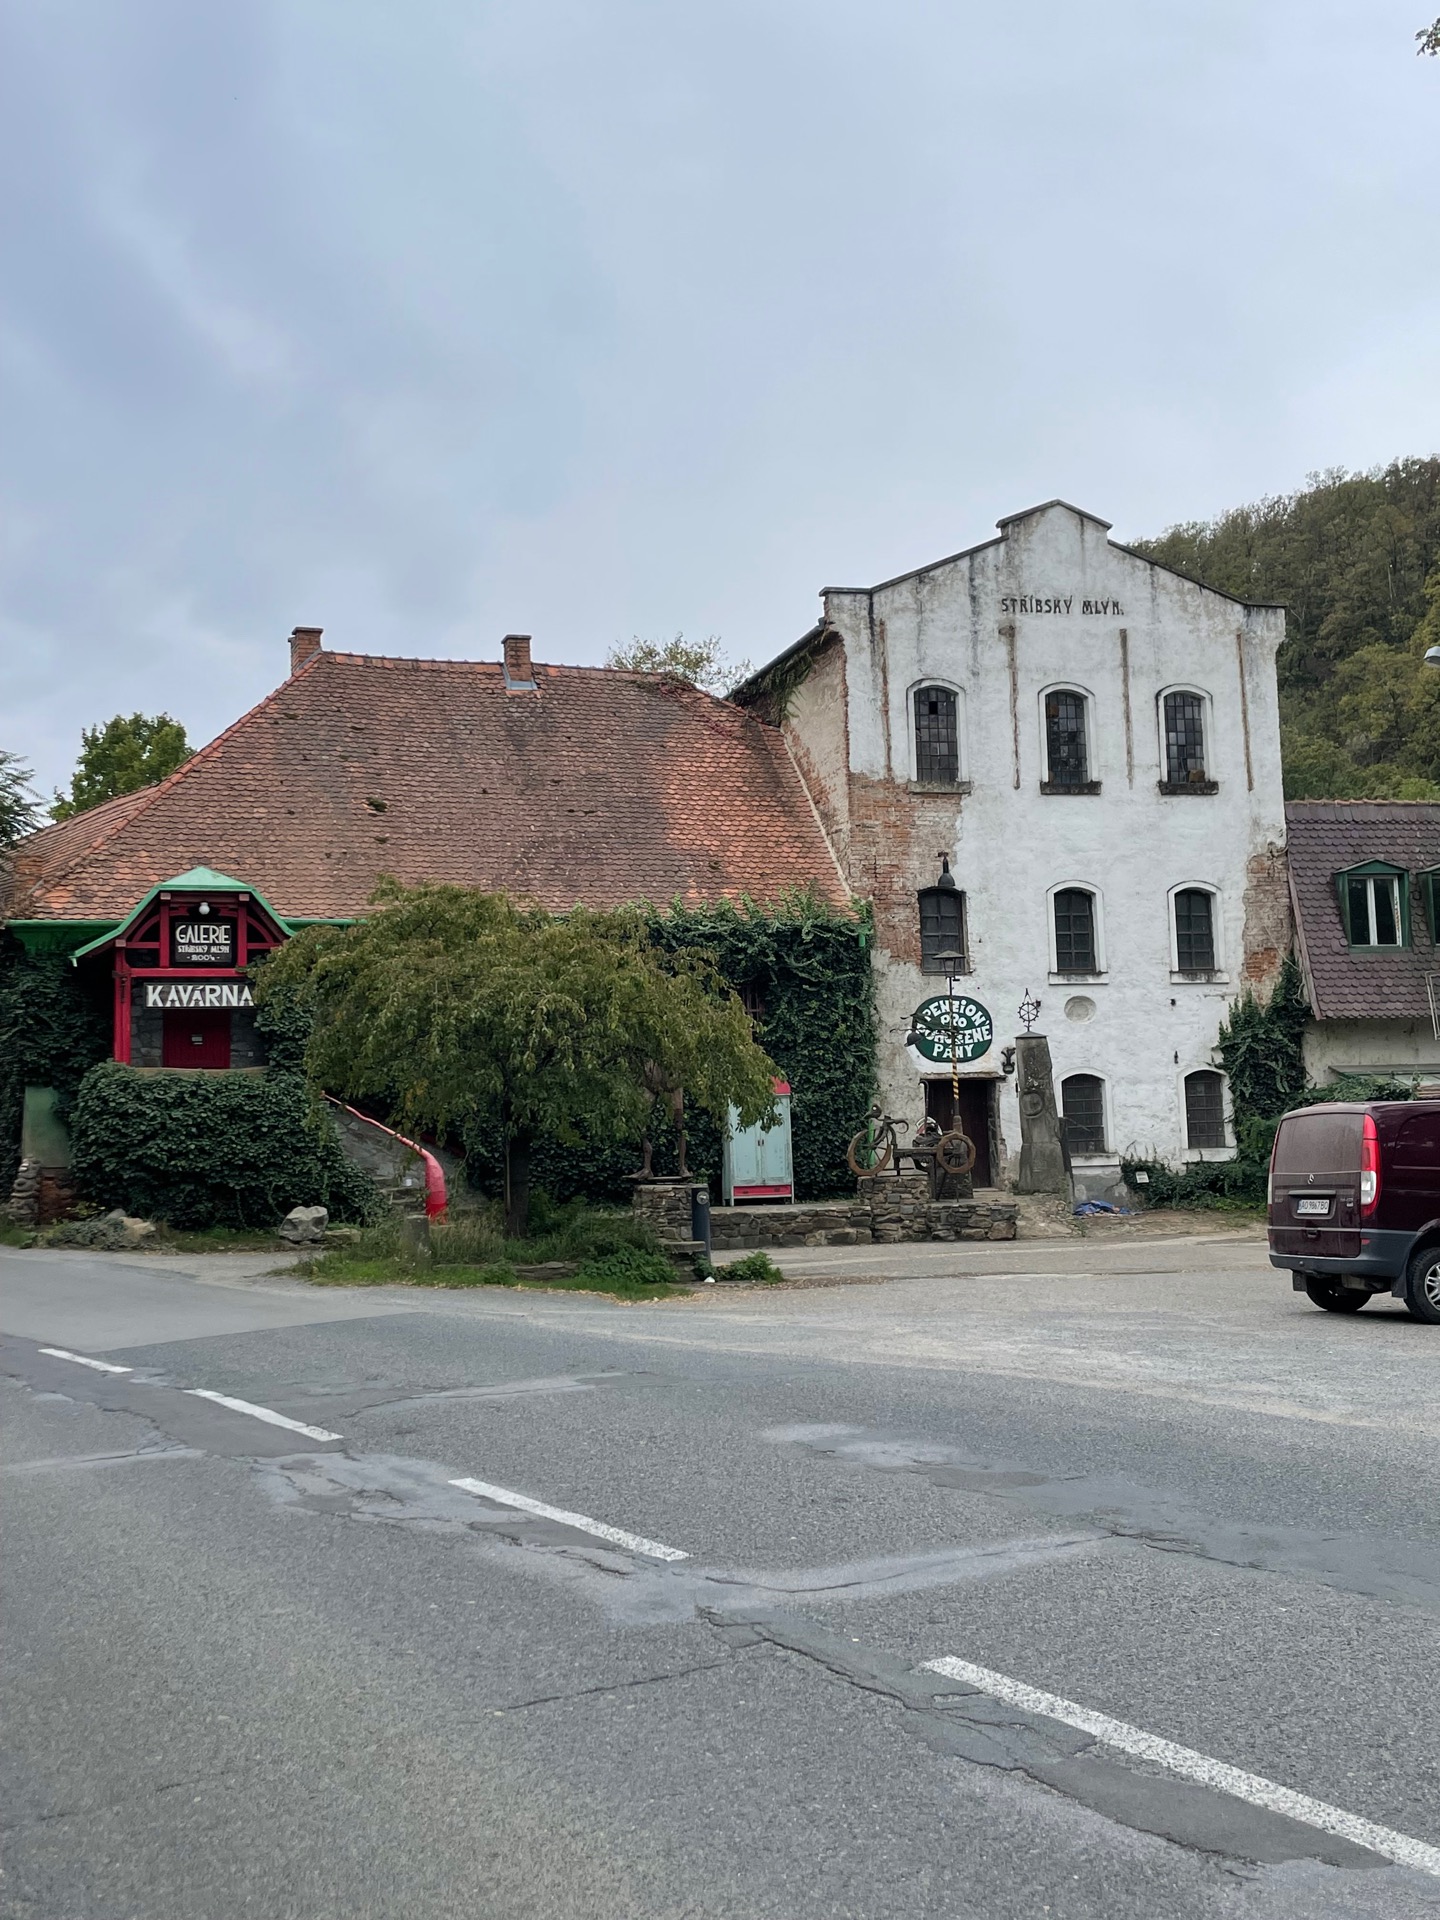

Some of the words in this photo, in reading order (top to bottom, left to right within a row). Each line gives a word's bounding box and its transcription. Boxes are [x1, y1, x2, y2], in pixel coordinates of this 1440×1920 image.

[1001, 595, 1073, 615] STŘÍBSKÝ
[146, 985, 255, 1008] KAVÁRNA
[940, 1013, 968, 1028] PRO
[932, 1043, 975, 1059] PÁNY
